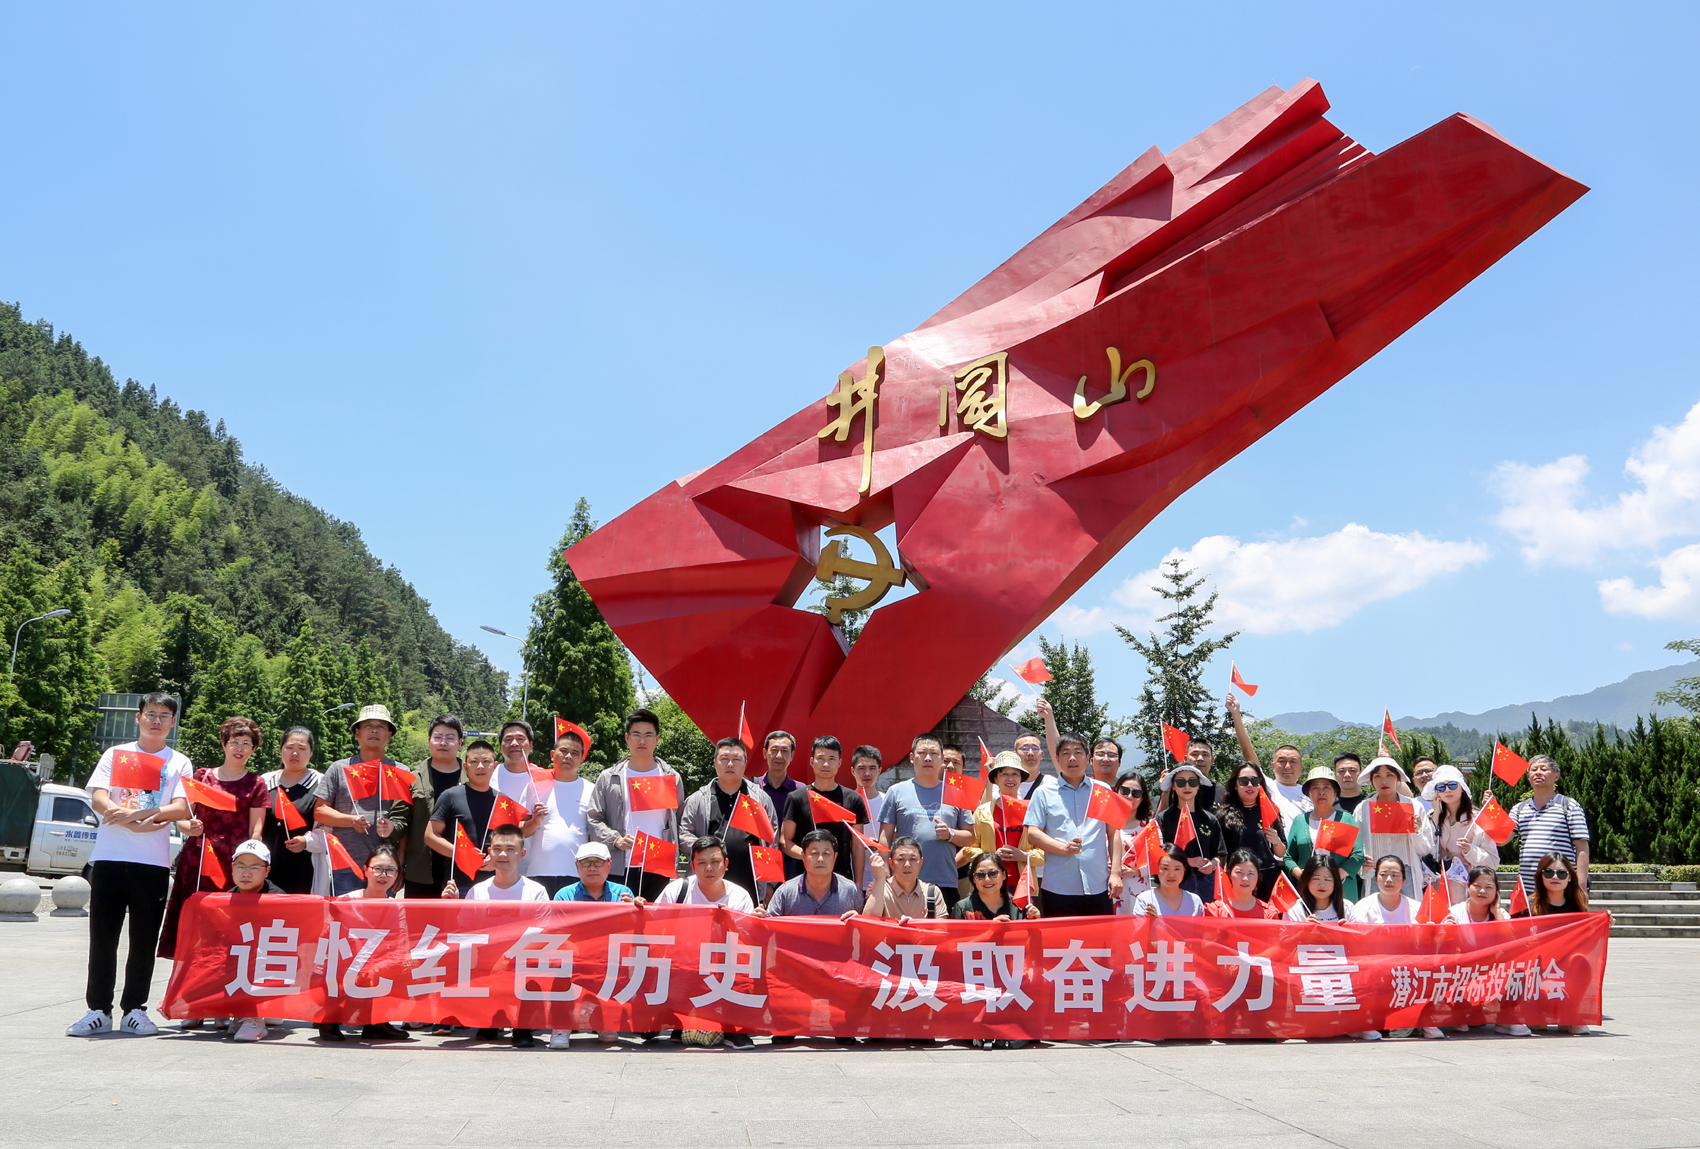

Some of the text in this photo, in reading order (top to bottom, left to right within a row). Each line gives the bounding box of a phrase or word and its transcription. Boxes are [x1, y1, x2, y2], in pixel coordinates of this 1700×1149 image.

[224, 918, 1361, 1014] 追忆红色历史 汲取奋进力量
[1388, 957, 1566, 1009] 潜江市招标投标协会
